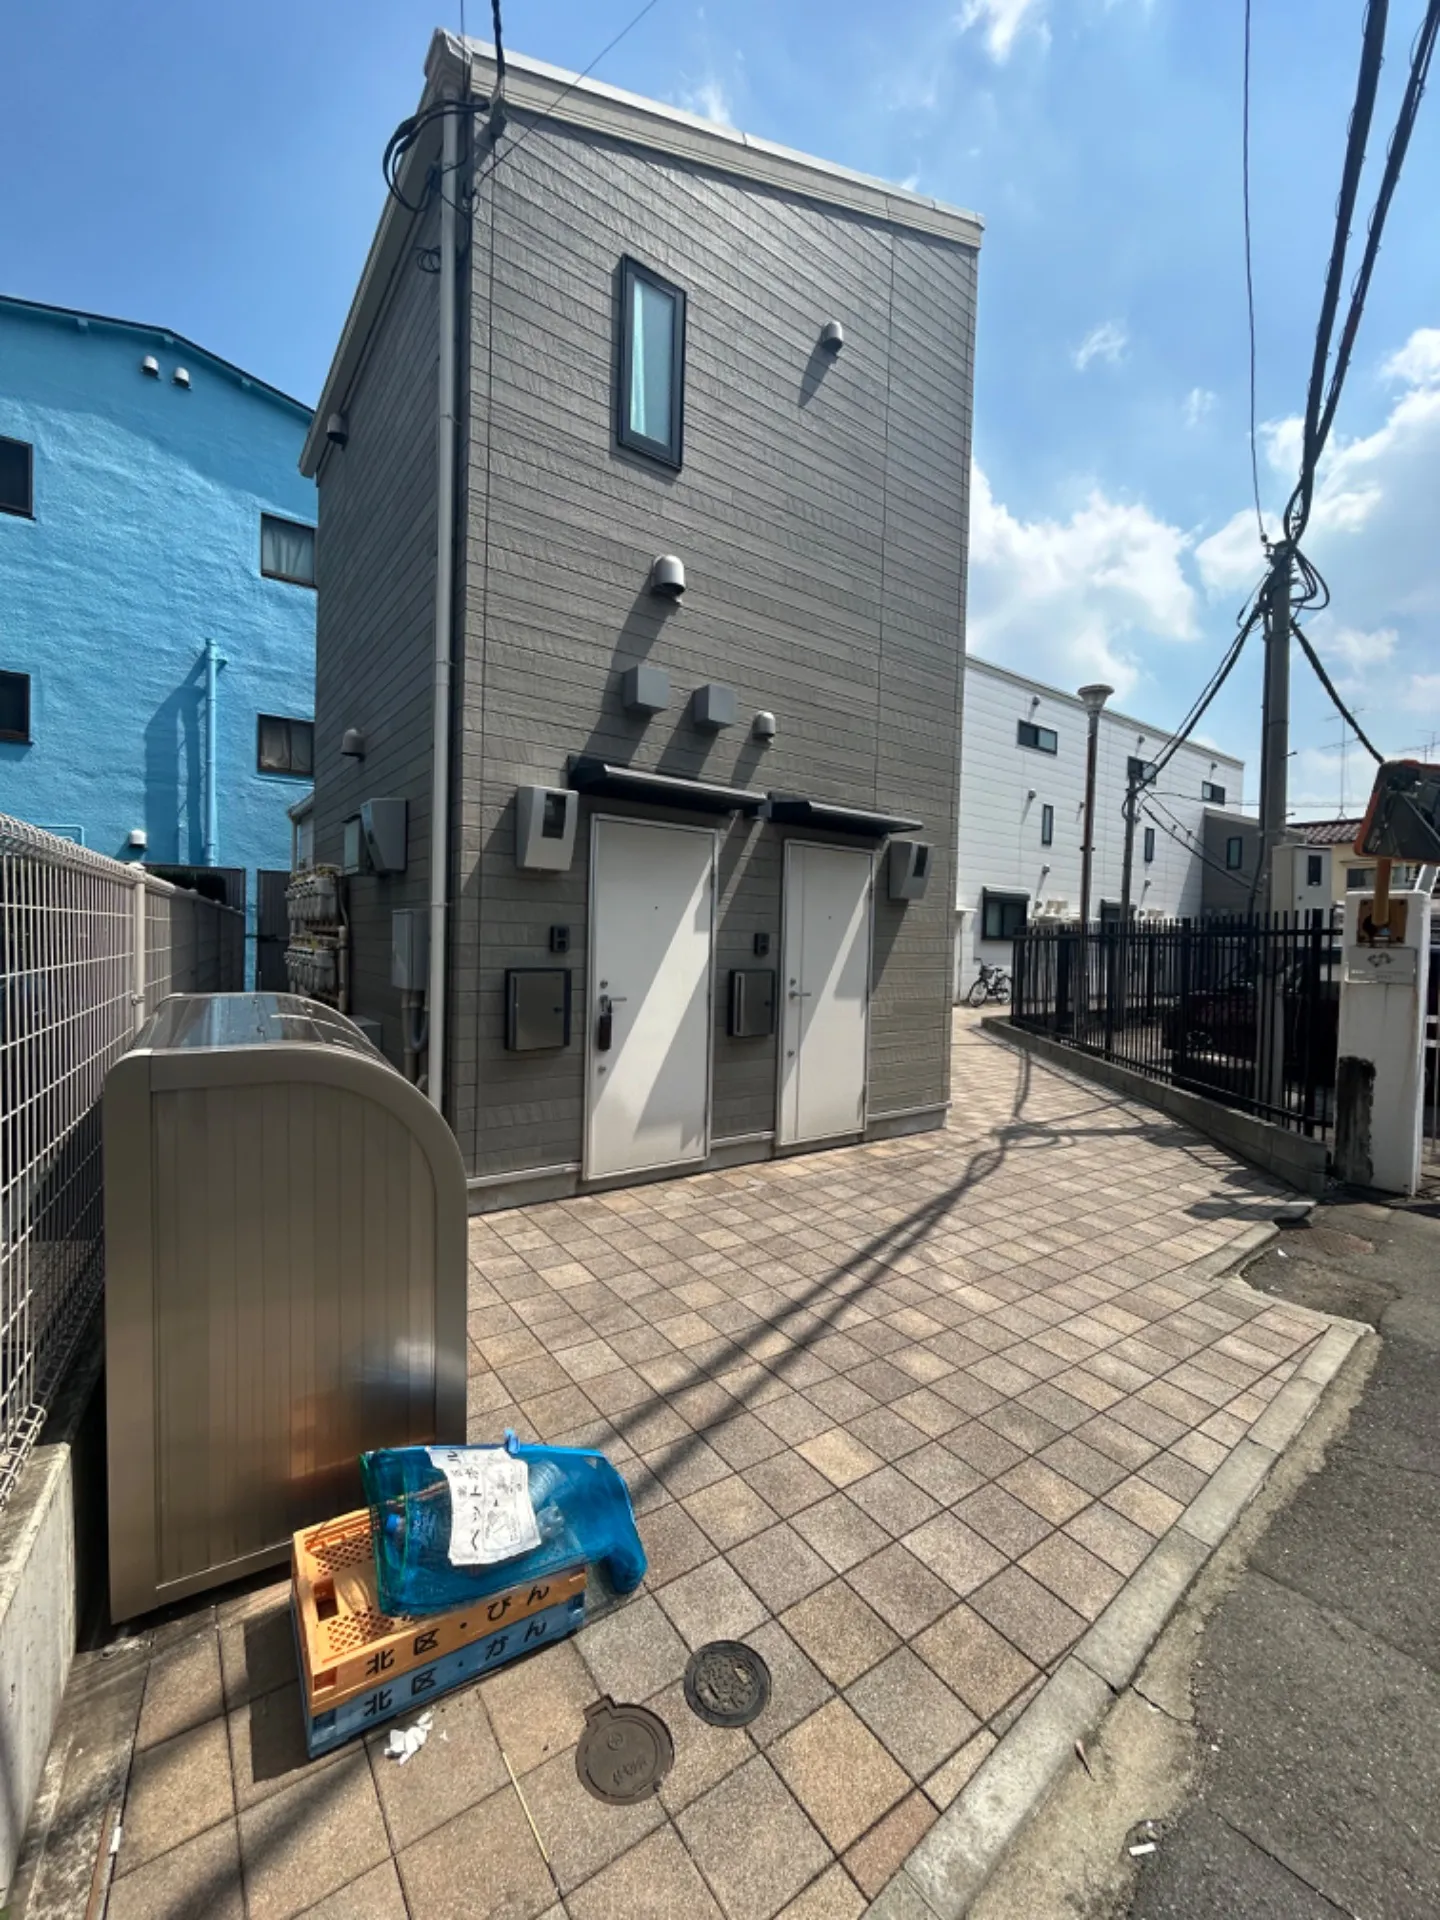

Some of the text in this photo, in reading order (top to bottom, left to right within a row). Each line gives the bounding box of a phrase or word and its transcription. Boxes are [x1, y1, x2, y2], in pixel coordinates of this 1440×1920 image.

[365, 1585, 550, 1676] 北区・びん
